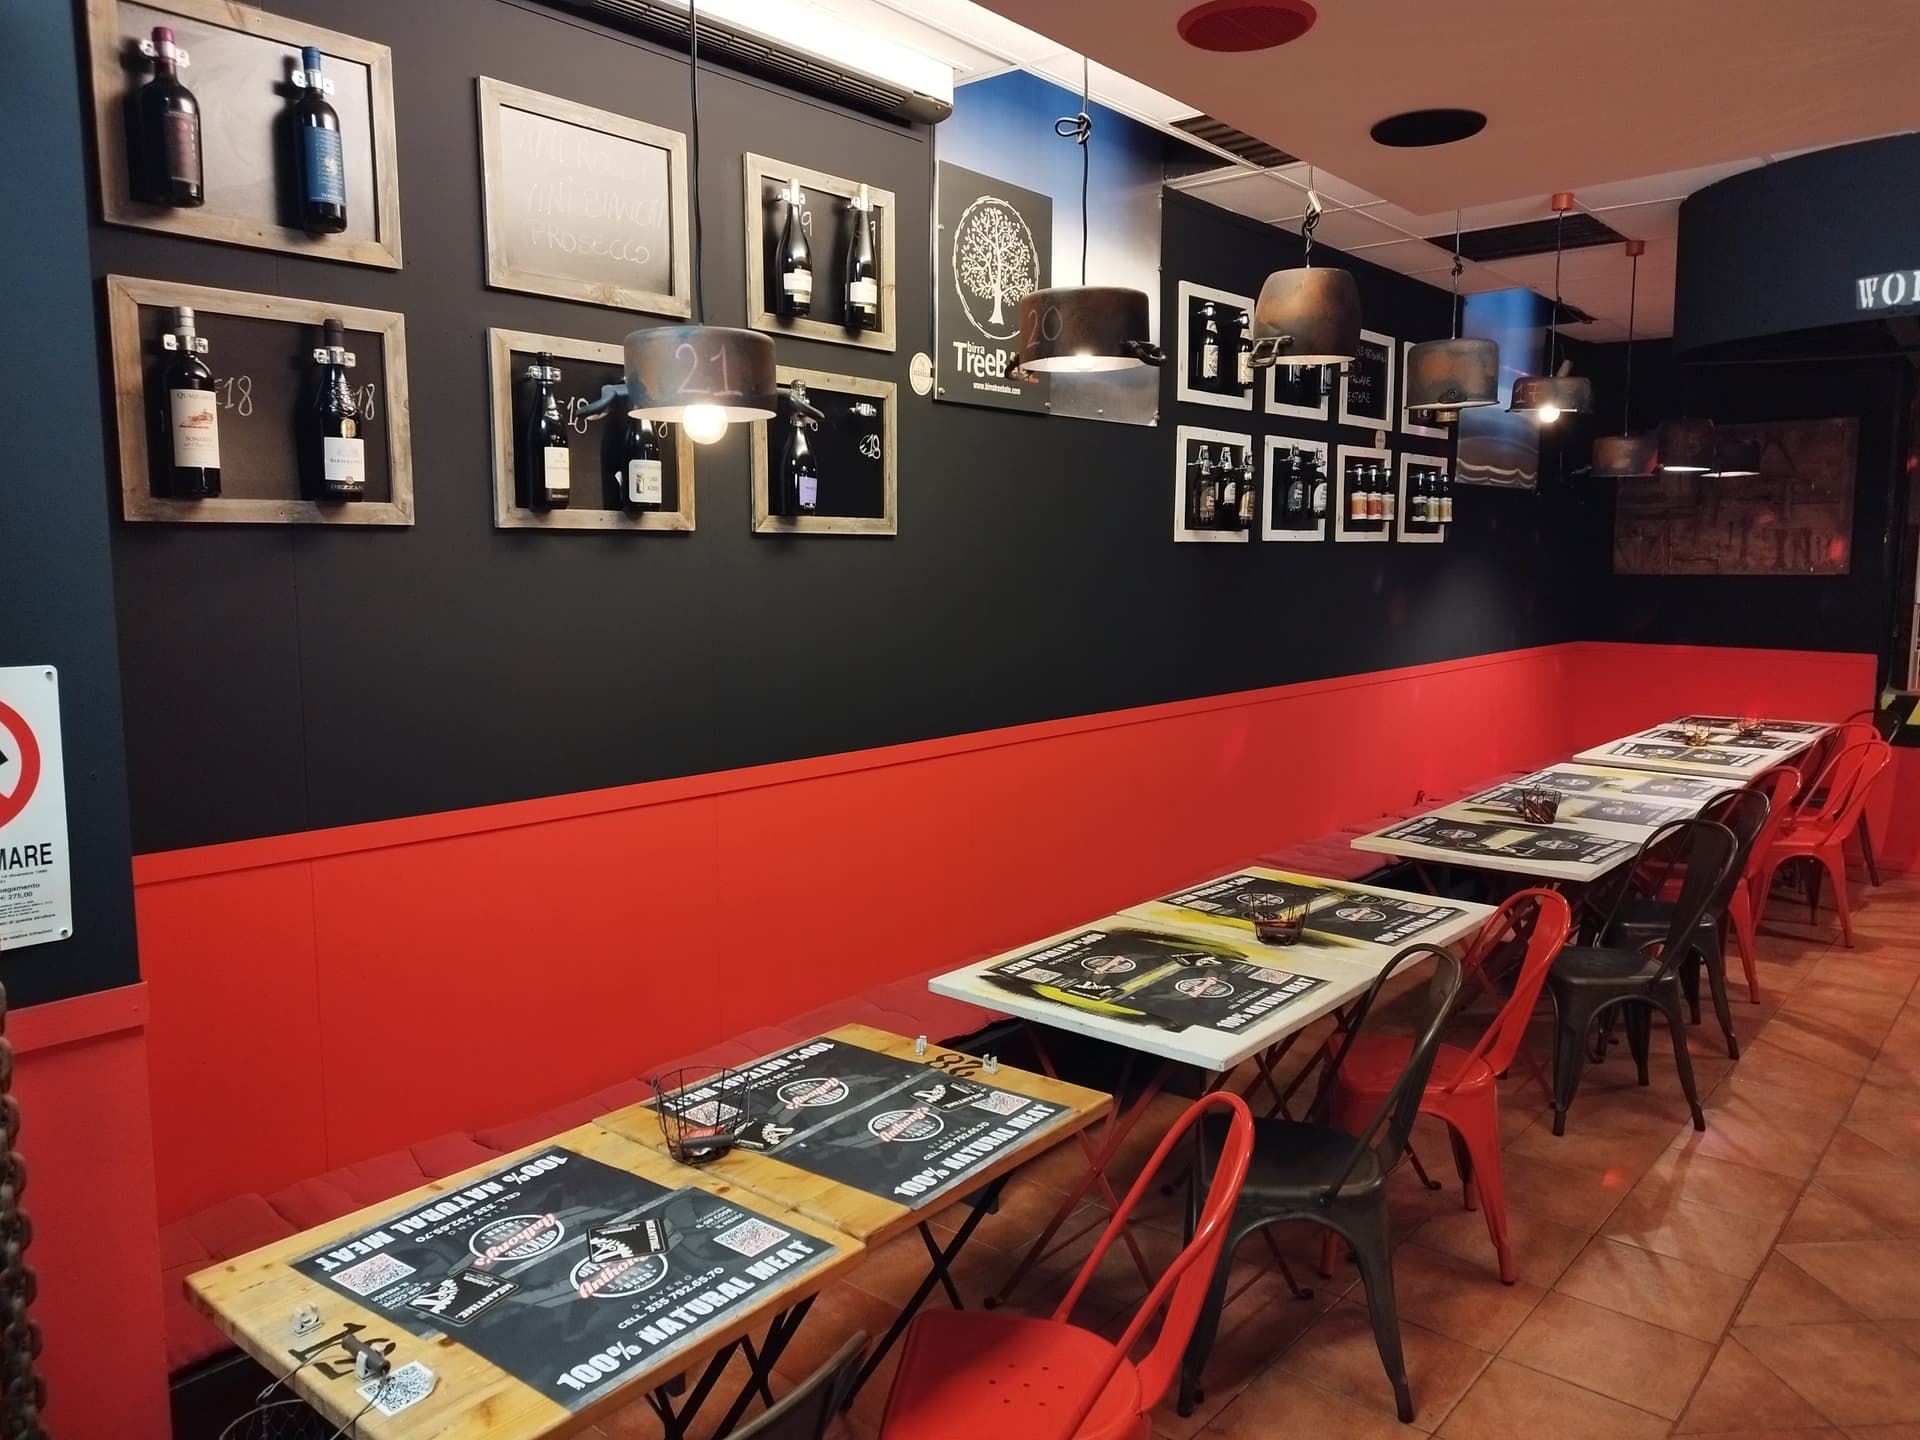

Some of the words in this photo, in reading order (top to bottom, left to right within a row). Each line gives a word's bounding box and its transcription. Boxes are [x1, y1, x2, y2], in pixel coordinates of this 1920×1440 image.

[521, 218, 650, 264] PROSECCO
[1026, 306, 1063, 348] 20
[967, 341, 985, 354] birra
[675, 343, 744, 397] 21
[1243, 991, 1293, 1014] NATURAL
[787, 1042, 834, 1060] 100%
[878, 1105, 930, 1143] Anthony's
[894, 1167, 950, 1197] 100%
[941, 1127, 1019, 1169] NATURAL
[1006, 1104, 1055, 1129] MEAT
[502, 1155, 568, 1184] 100%
[390, 1181, 504, 1234] NATURAL
[473, 1203, 496, 1215] 335
[495, 1192, 520, 1203] CELL.
[415, 1214, 474, 1242] 792.65.70
[474, 1212, 556, 1267] Anthony's
[504, 1229, 558, 1258] OFFICINE
[315, 1231, 395, 1272] MEAT
[455, 1283, 518, 1318] MEANTIME.
[618, 1313, 647, 1329] CELL.
[644, 1297, 669, 1312] 335
[668, 1267, 724, 1299] 792.65.70
[631, 1274, 692, 1310] GIAVENO
[556, 1341, 642, 1390] 100%
[635, 1277, 755, 1345] NATURAL
[745, 1239, 814, 1280] MEAT
